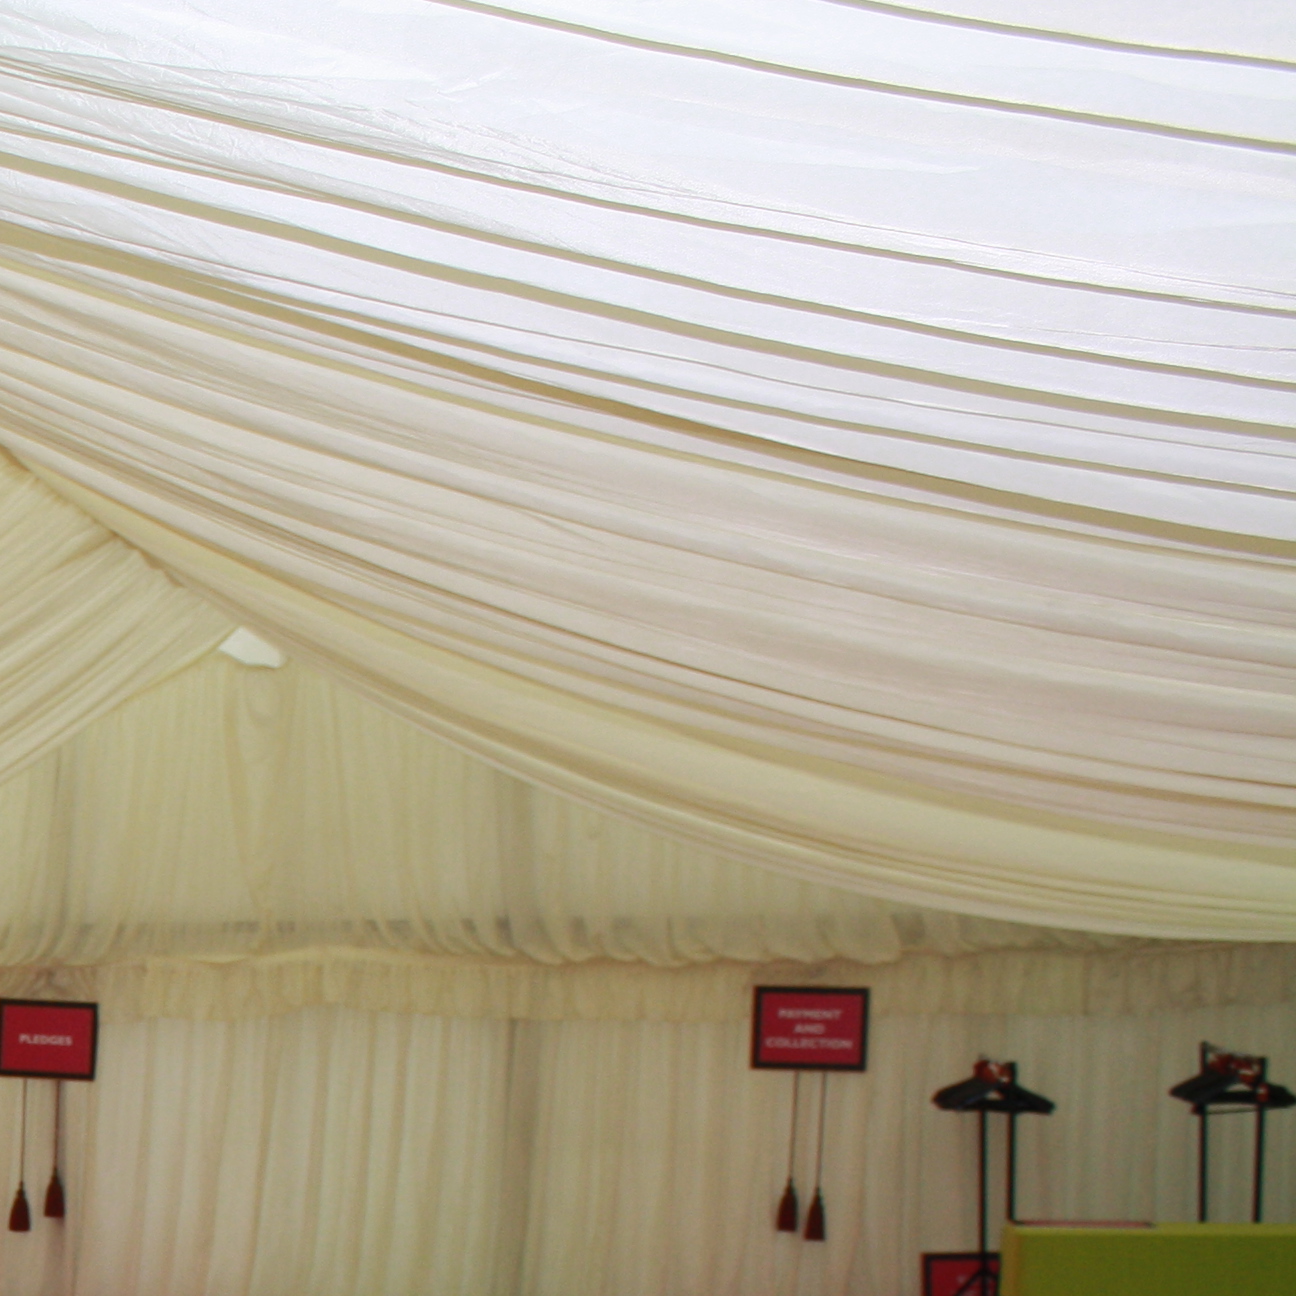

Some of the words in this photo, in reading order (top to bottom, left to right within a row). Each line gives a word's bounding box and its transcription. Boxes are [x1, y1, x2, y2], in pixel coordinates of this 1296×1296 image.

[777, 1007, 842, 1020] PAYMENT
[794, 1023, 826, 1034] AND
[18, 1033, 73, 1047] PLEDGES
[765, 1037, 853, 1050] COLLECTION
